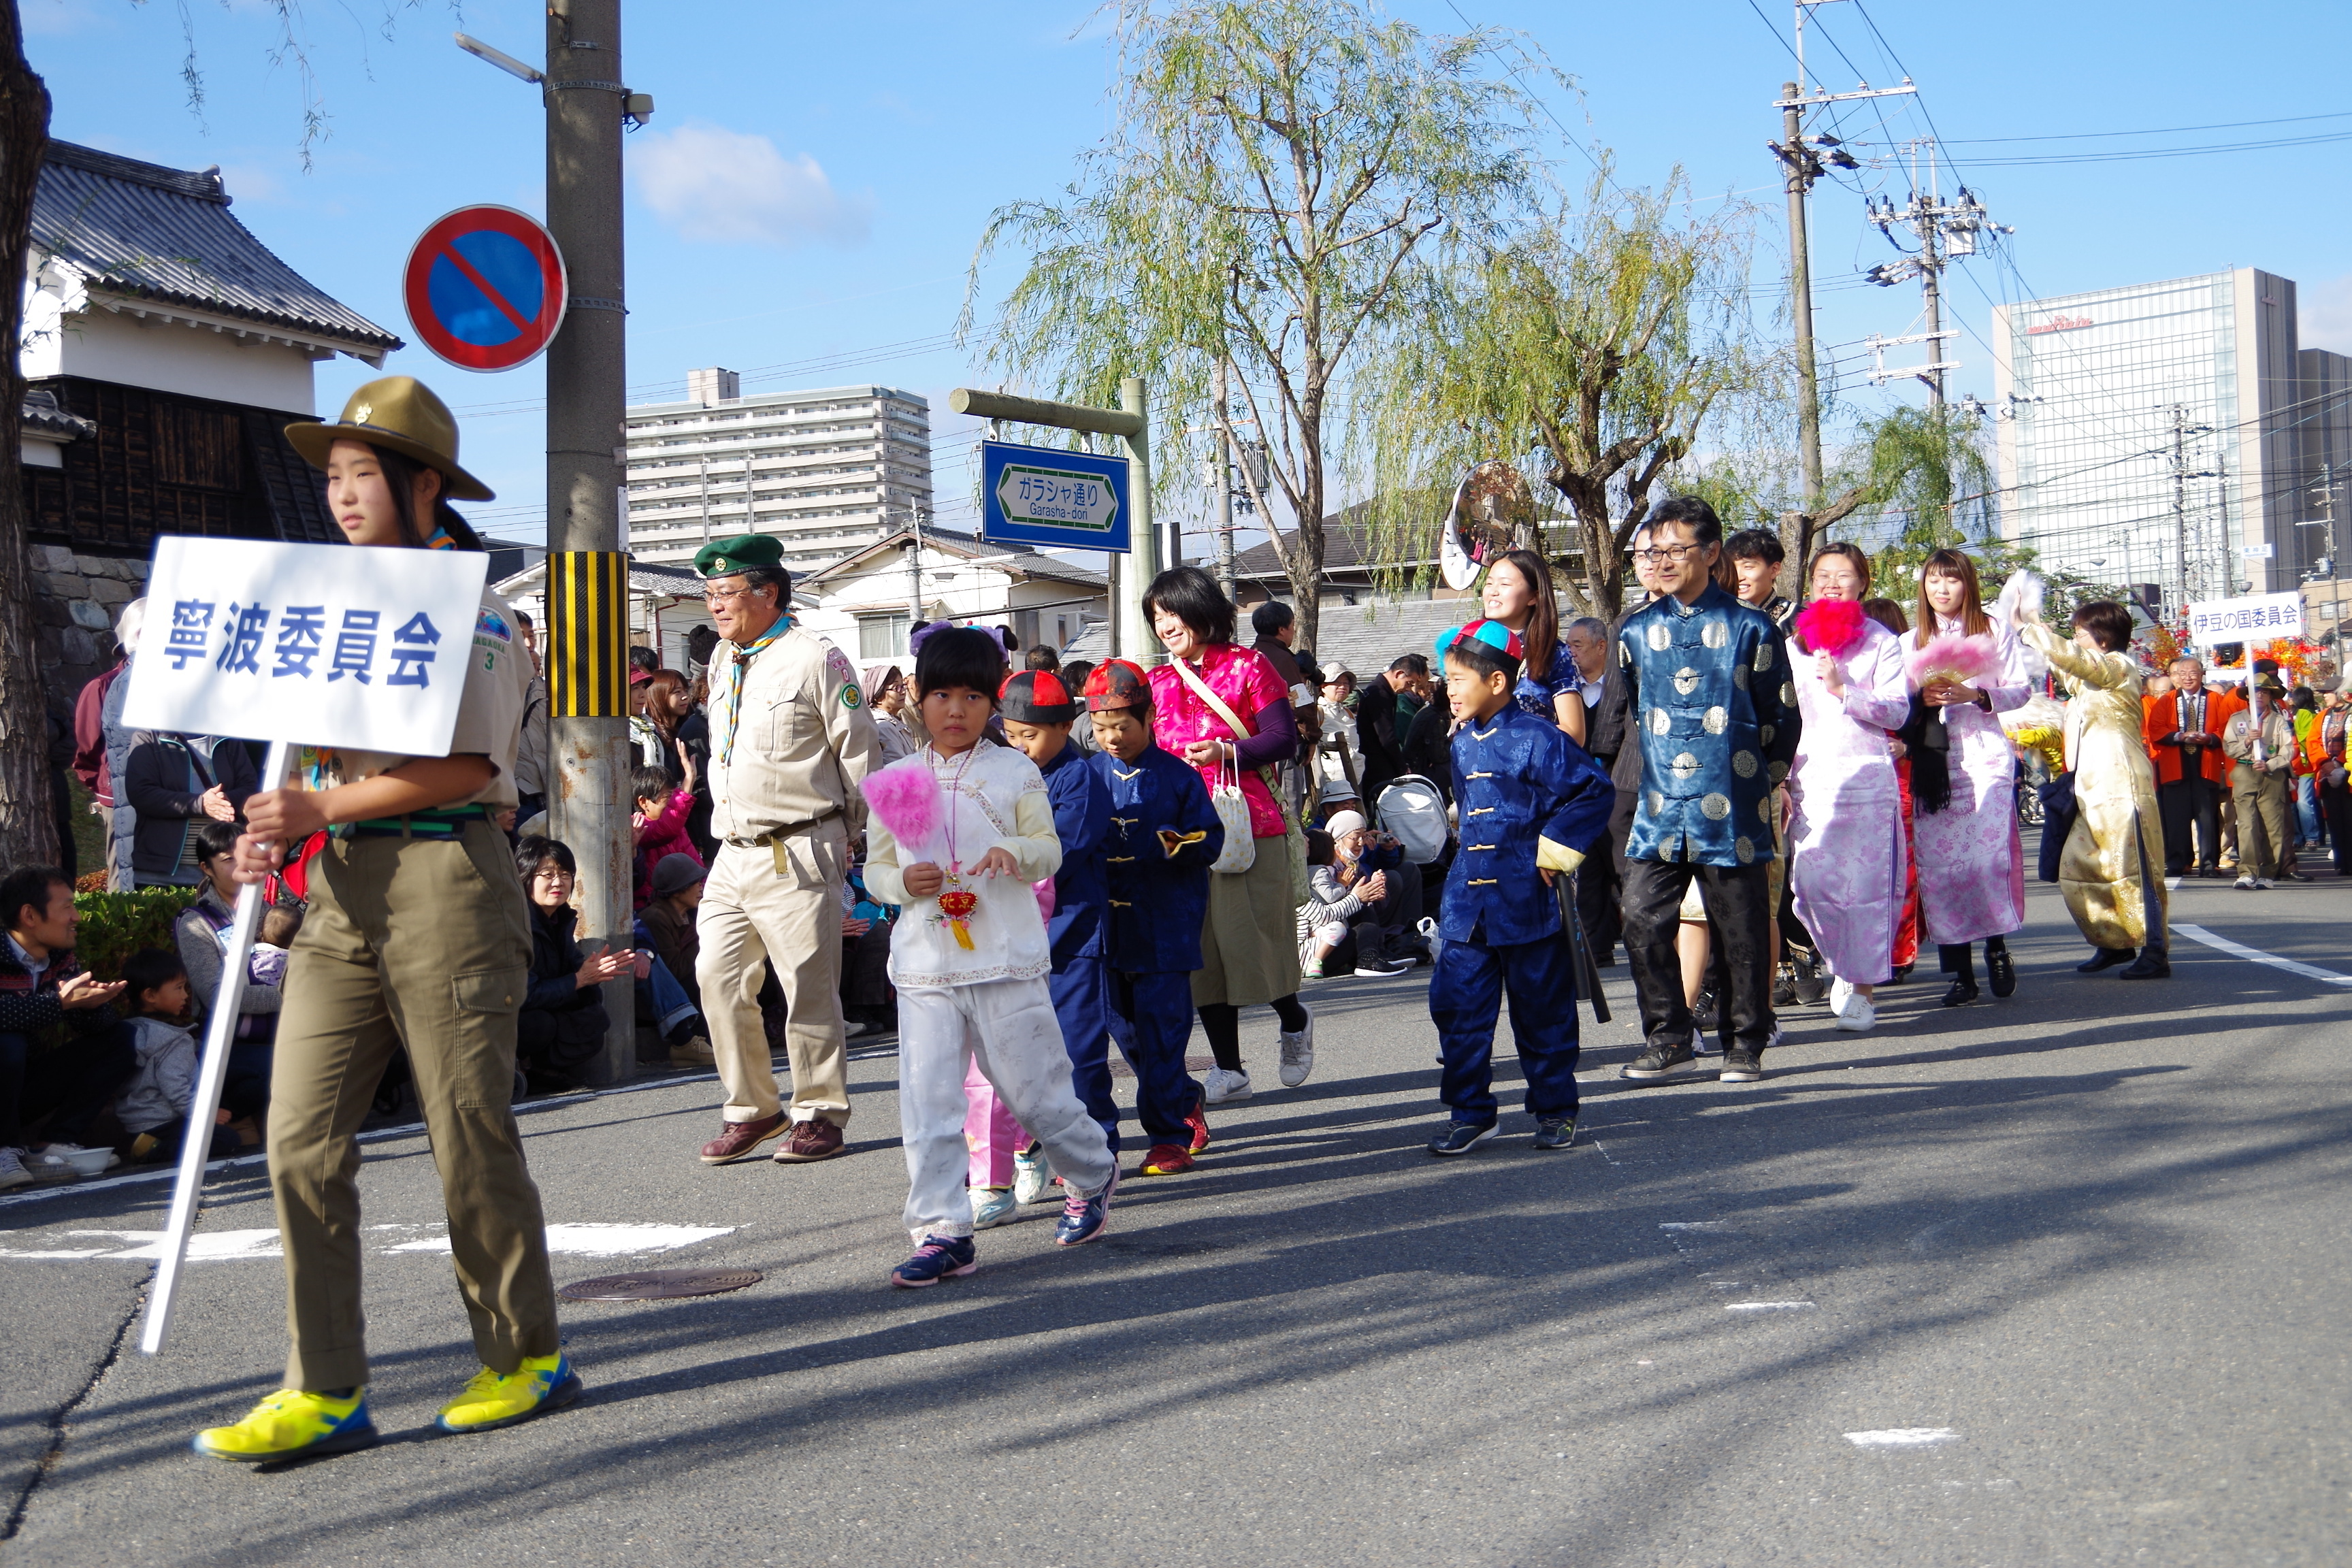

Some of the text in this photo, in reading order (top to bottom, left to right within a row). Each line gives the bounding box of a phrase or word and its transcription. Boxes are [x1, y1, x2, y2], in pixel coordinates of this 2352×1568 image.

[1019, 477, 1097, 506] ガラシャ通り
[1030, 502, 1088, 520] Garasha-dori
[2193, 604, 2297, 634] 伊豆の国委員会
[164, 598, 442, 690] 寧波委員会
[485, 652, 494, 670] 3
[941, 894, 972, 909] 北京
